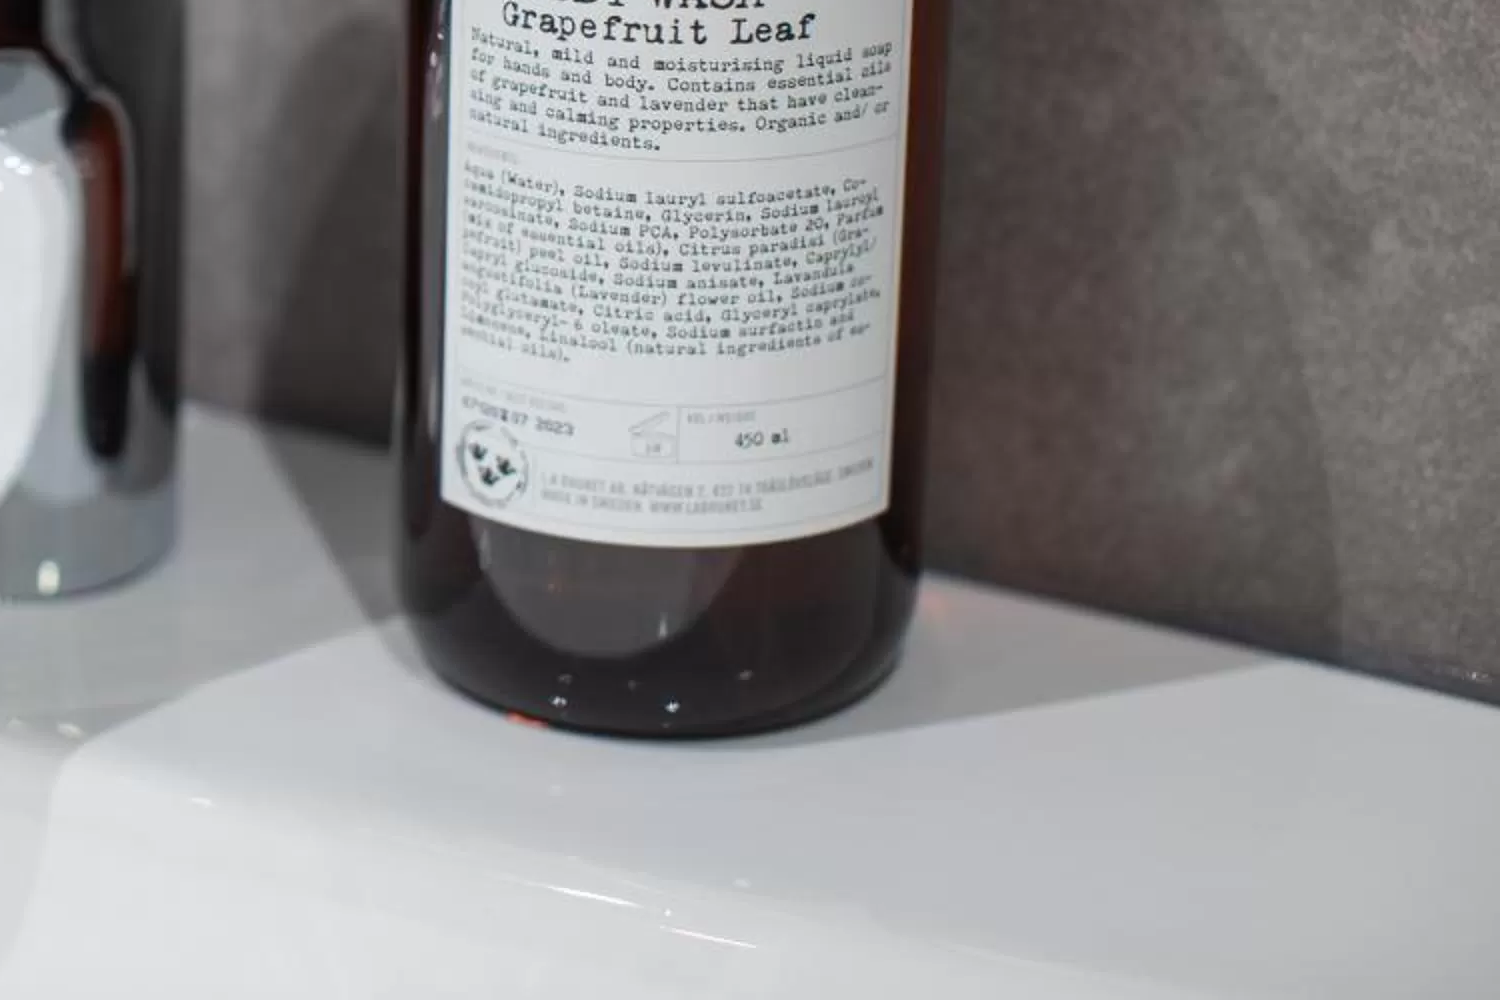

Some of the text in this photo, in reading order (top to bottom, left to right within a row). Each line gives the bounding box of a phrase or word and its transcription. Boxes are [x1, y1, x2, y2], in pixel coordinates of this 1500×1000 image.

[502, 1, 816, 44] Grapefruit Leaf
[472, 27, 893, 74] Natural, mild and moisturising liquid soap
[471, 47, 891, 93] for hands and body. Contains essential oils
[471, 68, 486, 82] of
[493, 77, 588, 103] grapefruit
[597, 94, 630, 109] and
[641, 96, 729, 112] lavender
[738, 98, 778, 112] that
[787, 92, 827, 109] have
[470, 89, 501, 107] sing
[510, 101, 537, 115] and
[546, 107, 620, 130] calming
[630, 118, 745, 134] properties.
[756, 112, 827, 133] Organic
[874, 101, 890, 114] or
[470, 108, 660, 151] natural ingredients.
[503, 169, 564, 196] (Water),
[574, 185, 637, 203] Sodium
[646, 192, 706, 208] lauryl
[716, 186, 835, 205] sulfoacetate,
[574, 201, 651, 222] betaine,
[661, 208, 751, 225] Glycerin,
[760, 203, 819, 220] Sodium
[569, 217, 631, 236] Sodium
[639, 224, 679, 240] PCA,
[689, 223, 798, 240] Polysorbate
[680, 243, 741, 256] Citrus
[750, 236, 825, 257] paradisi
[620, 256, 683, 272] Sodium
[614, 273, 677, 289] Sodium
[677, 292, 741, 306] flower
[748, 289, 783, 303] oil,
[791, 281, 845, 299] Sodium
[593, 303, 654, 321] Citric
[664, 308, 711, 323] acid,
[721, 303, 798, 323] Glyceryl
[666, 326, 730, 339] Sodium
[717, 335, 821, 357] ingredients
[735, 428, 789, 448] 450 ml
